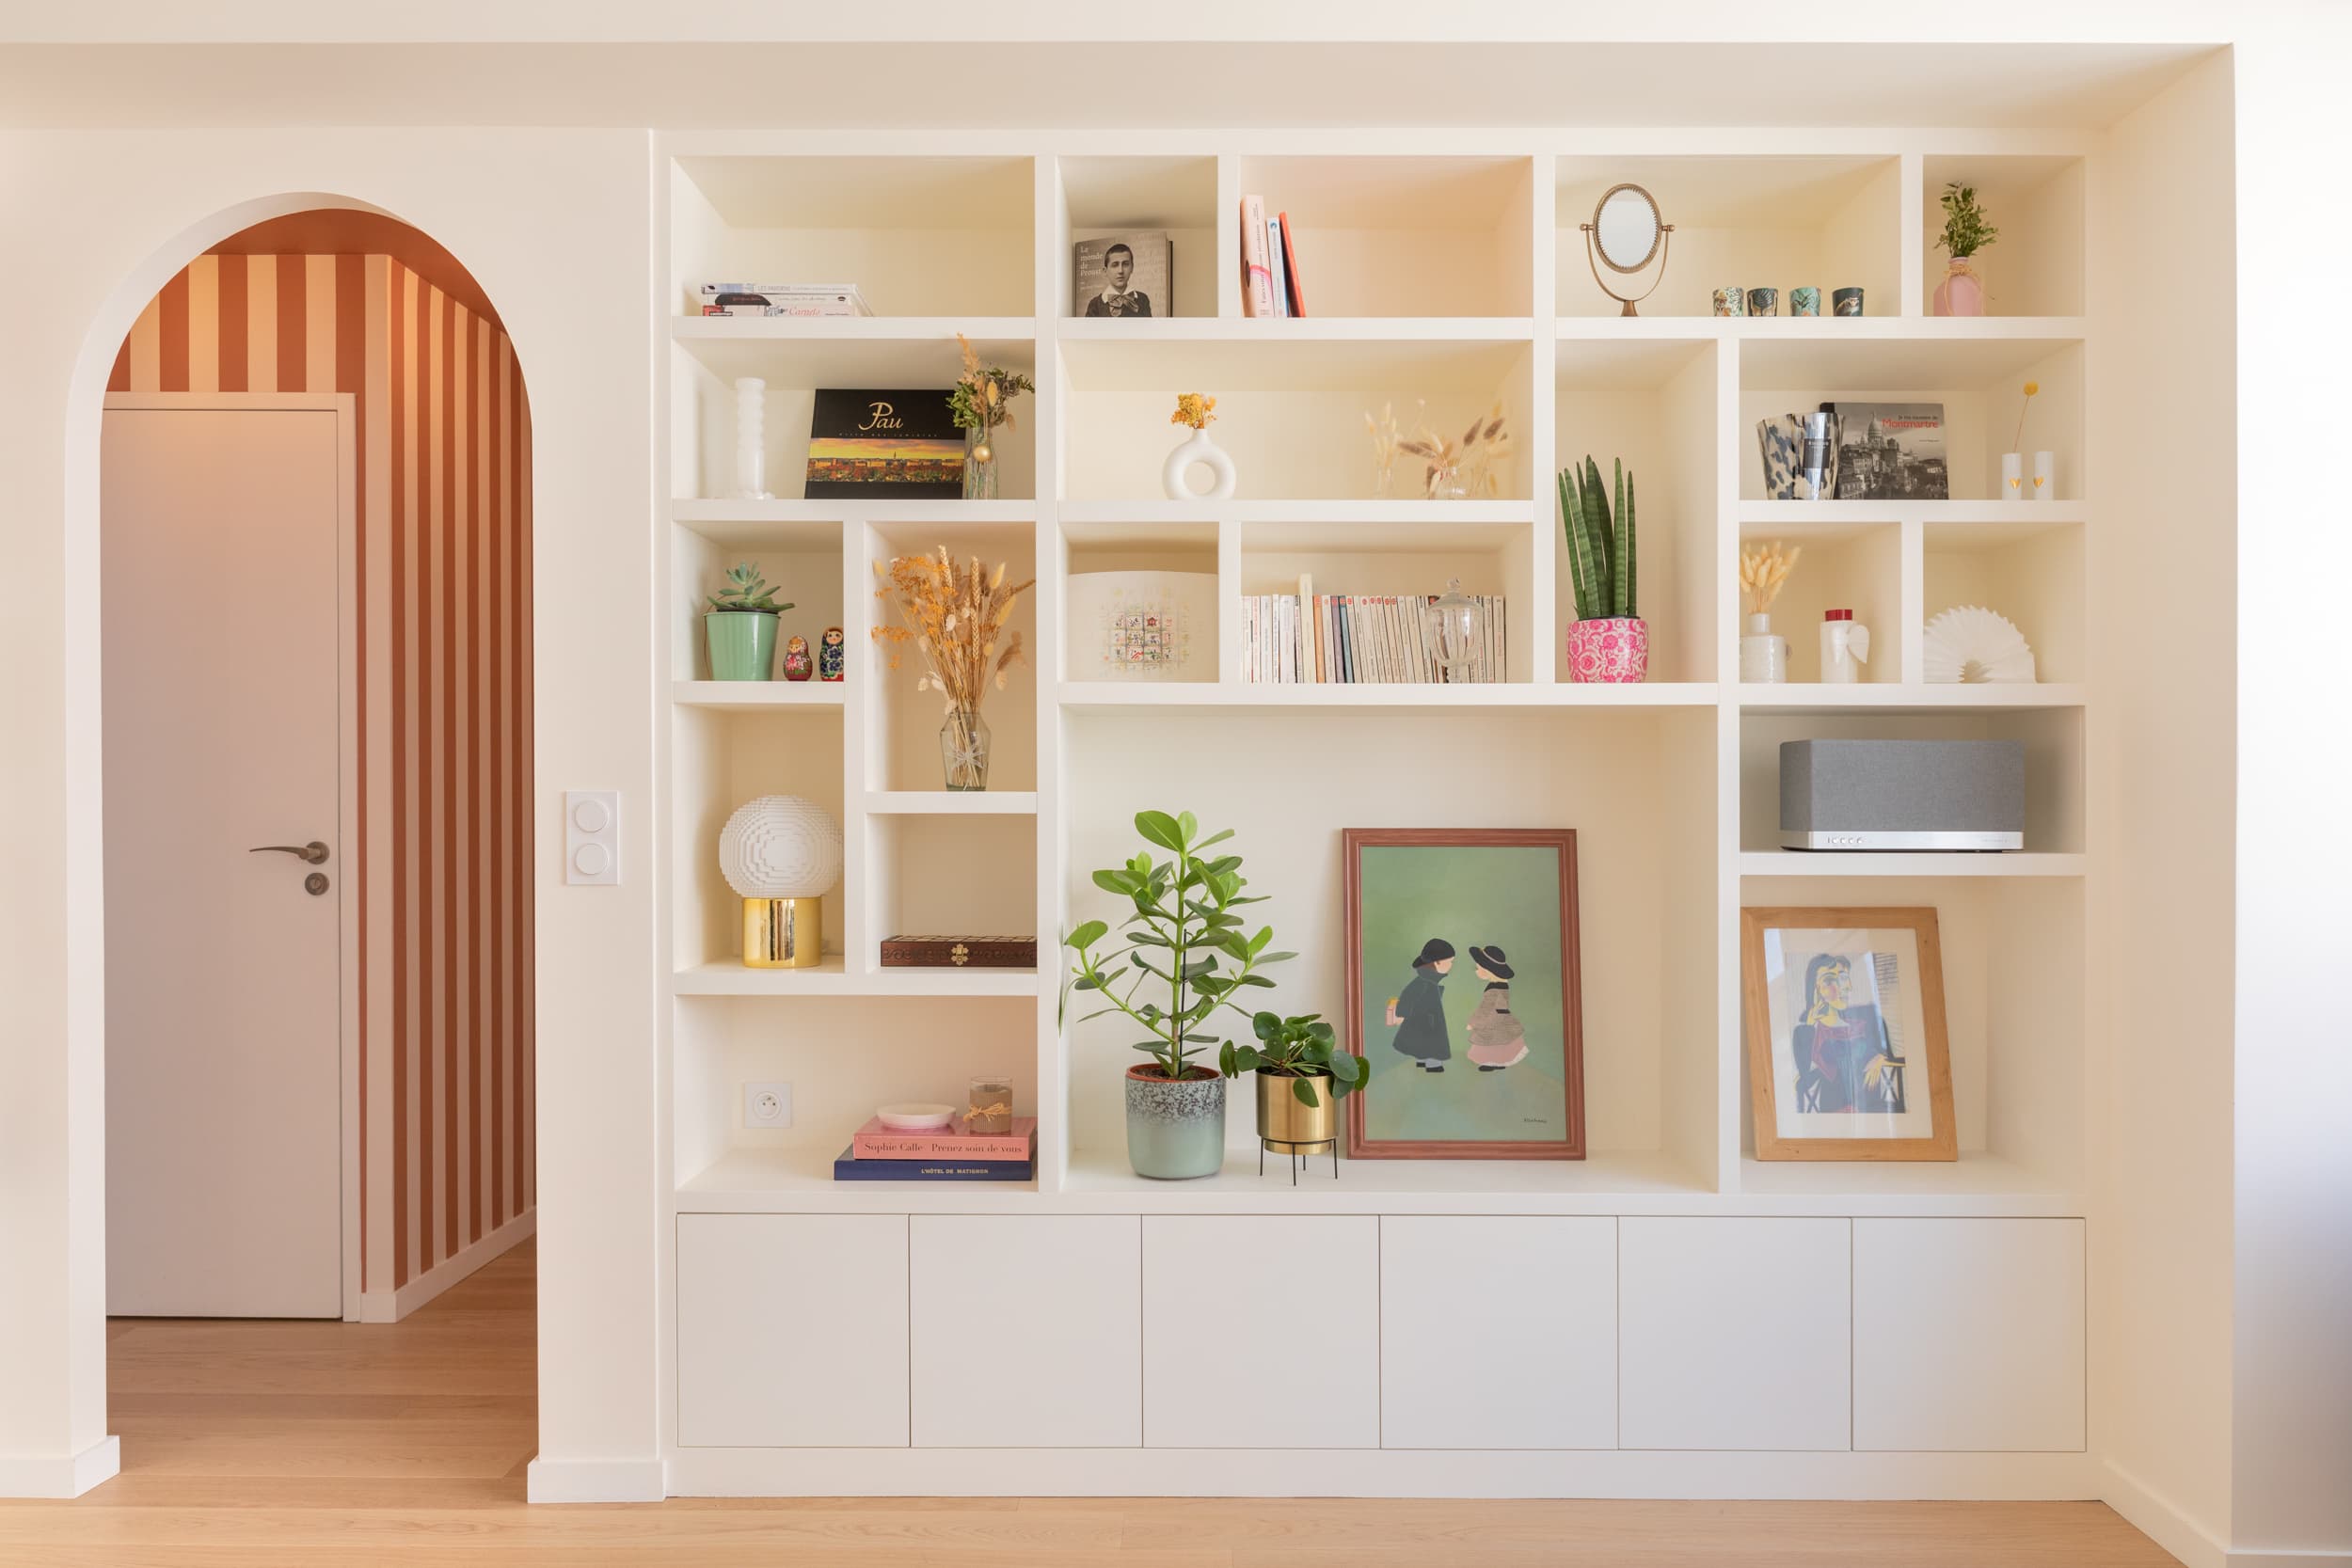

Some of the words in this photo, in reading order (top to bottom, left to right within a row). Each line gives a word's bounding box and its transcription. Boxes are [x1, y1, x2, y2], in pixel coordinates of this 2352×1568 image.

[1080, 252, 1103, 261] monde
[858, 402, 903, 431] Pau
[1882, 419, 1939, 428] Montmartre
[865, 1143, 898, 1154] Sophie
[899, 1143, 923, 1153] Calle
[931, 1143, 963, 1153] Prenez
[965, 1144, 984, 1153] soin
[987, 1144, 998, 1153] de
[1001, 1145, 1023, 1153] vous
[921, 1166, 945, 1175] L'HÔTEL
